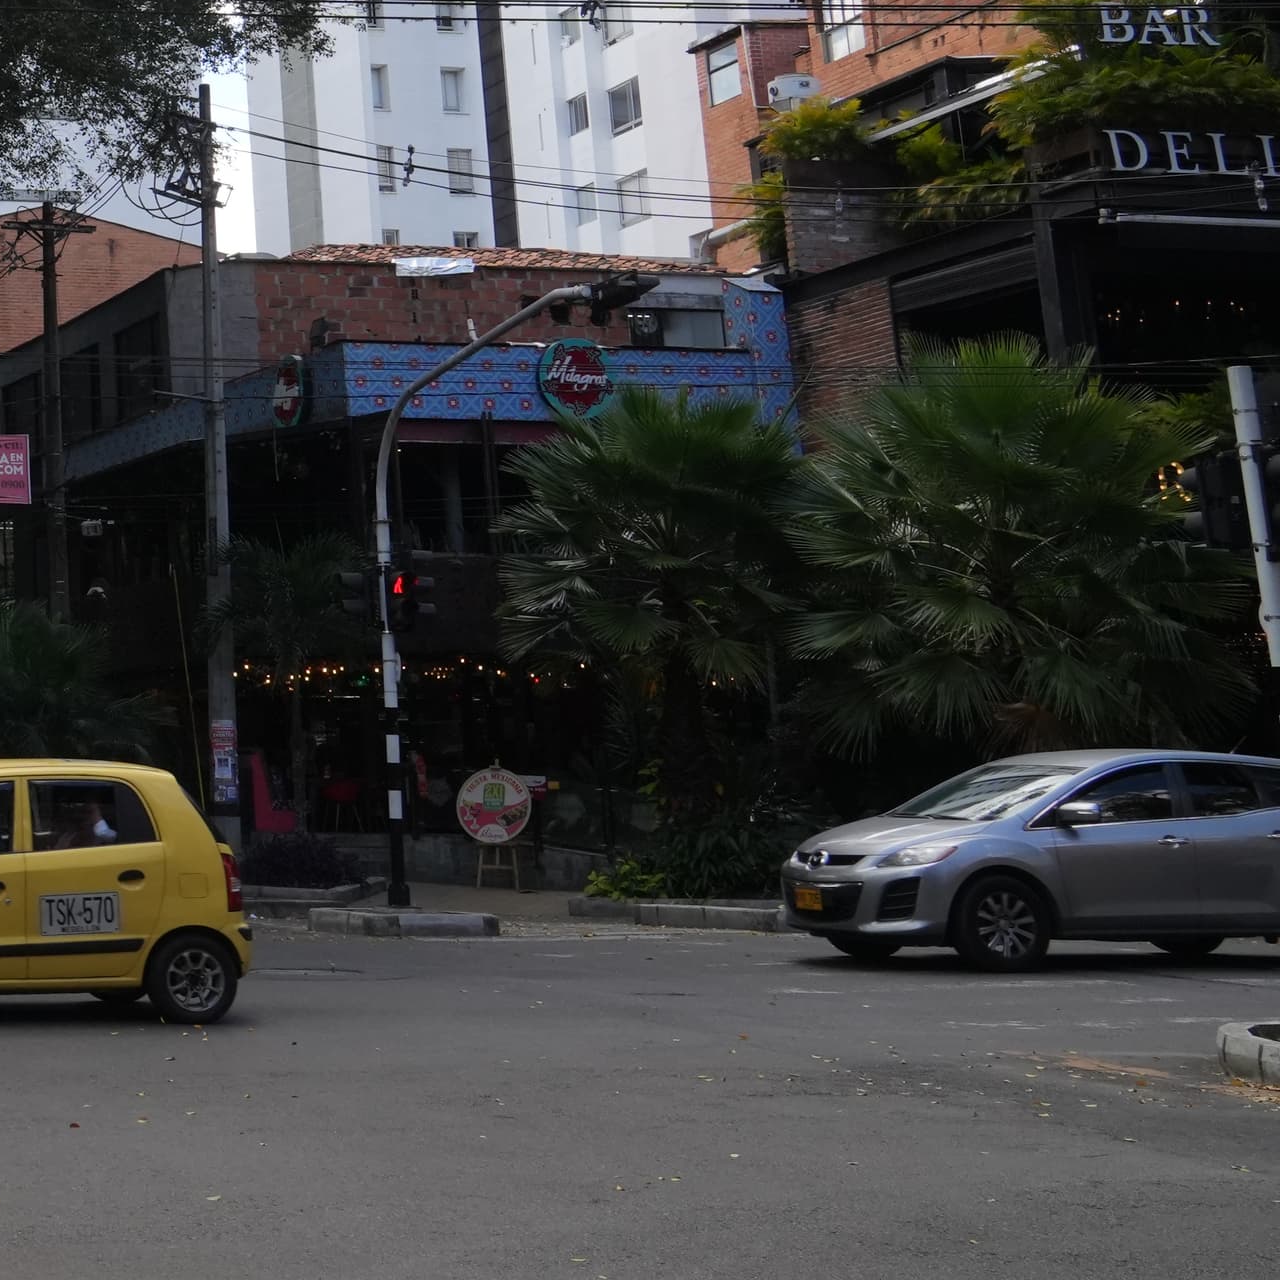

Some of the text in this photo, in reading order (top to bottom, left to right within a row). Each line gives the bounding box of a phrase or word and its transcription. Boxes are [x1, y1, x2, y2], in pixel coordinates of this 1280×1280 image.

[1096, 2, 1221, 47] BAR
[1101, 129, 1280, 178] DELI
[548, 356, 609, 391] Milagros
[10, 453, 23, 462] EN
